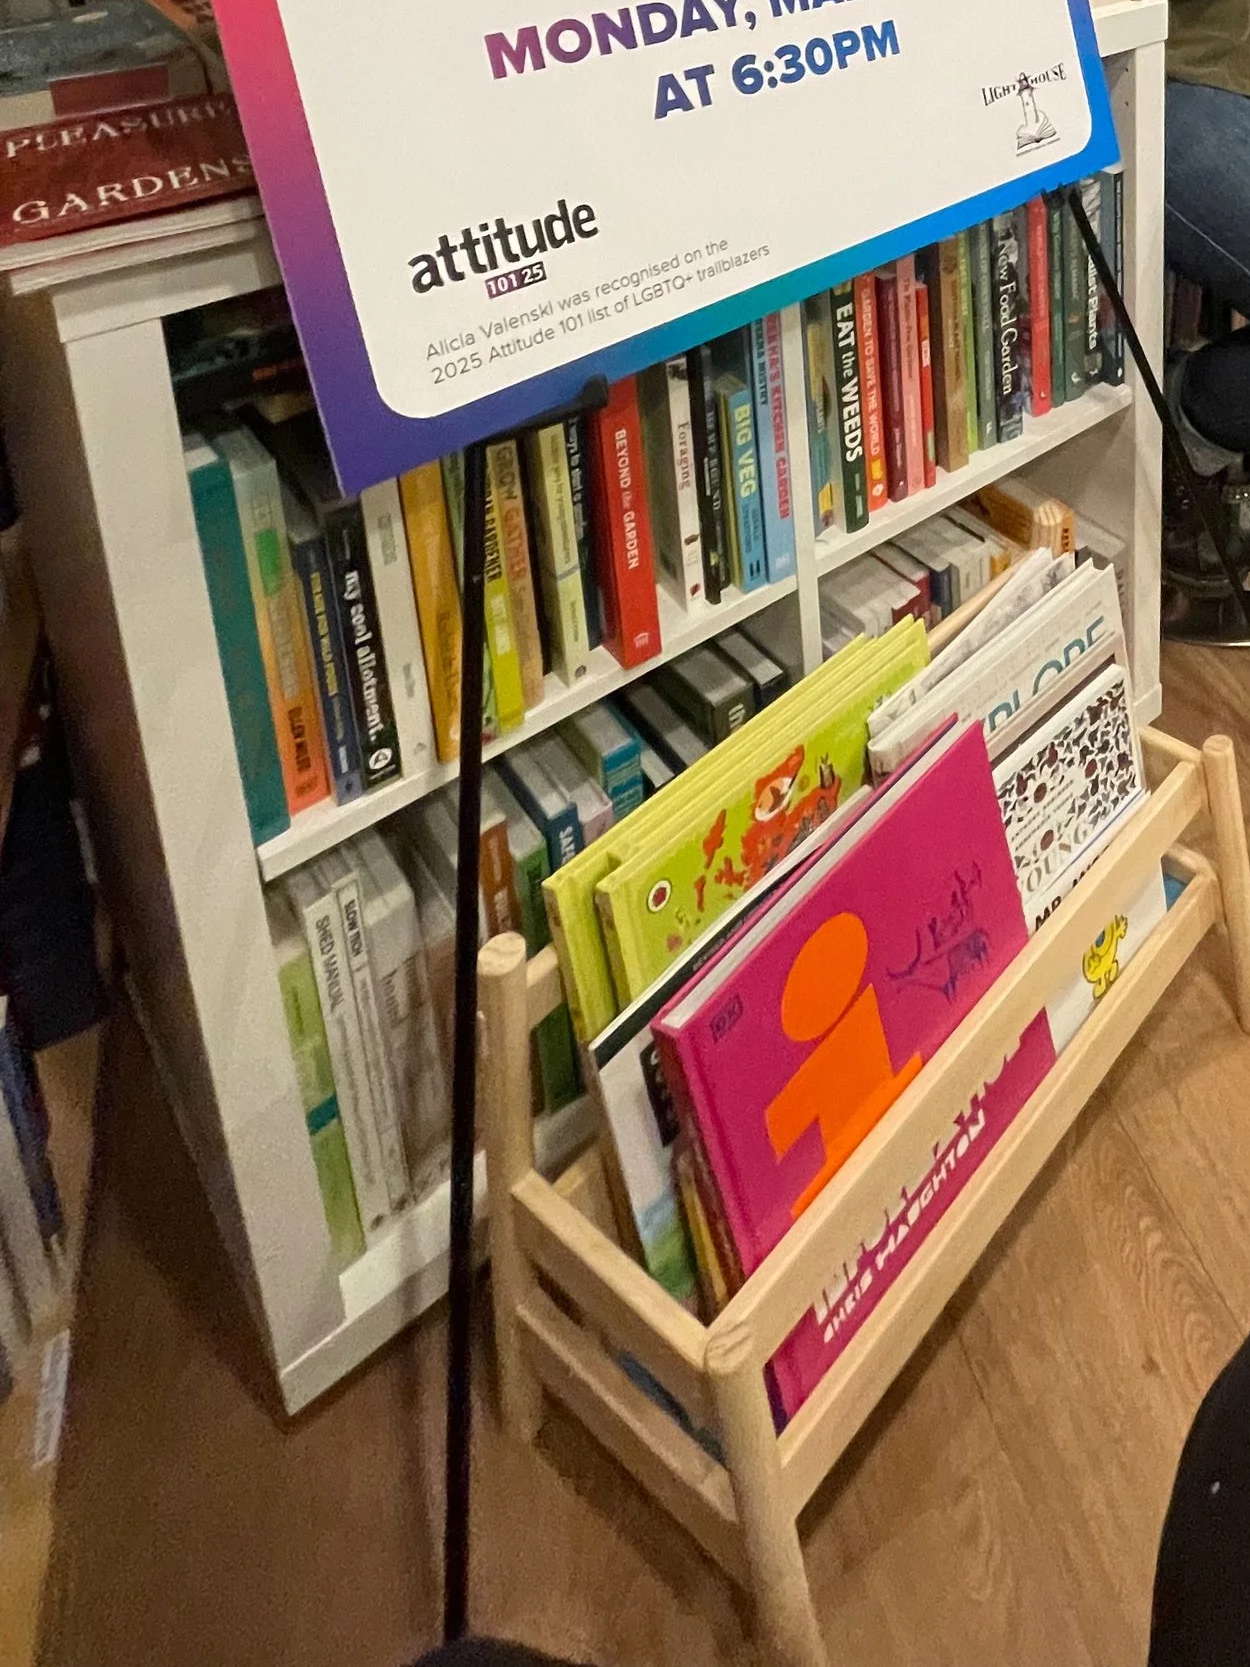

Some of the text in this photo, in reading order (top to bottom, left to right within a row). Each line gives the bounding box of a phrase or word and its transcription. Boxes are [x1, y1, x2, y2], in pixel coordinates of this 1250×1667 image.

[653, 20, 901, 120] AT 6:30PM
[6, 99, 236, 159] PLEASURE
[12, 154, 255, 226] GARDENS
[408, 199, 599, 294] attitude
[426, 237, 728, 361] Alicia Valenski was recognised on the
[432, 241, 771, 385] 2025 Attitude 101 list of LGBTQ+ trailblazers
[487, 264, 545, 297] 101 25
[860, 287, 874, 337] GARDEN
[864, 339, 876, 355] TO
[998, 236, 1018, 396] New Food Garden
[1088, 300, 1099, 351] Plants
[758, 362, 768, 407] MISTRY
[836, 301, 863, 463] EAT the WEEDS
[867, 389, 880, 412] THE
[734, 402, 752, 447] BIG
[770, 383, 786, 454] KITCHEN
[869, 413, 882, 456] WORLD
[615, 429, 632, 488] BEYOND
[676, 421, 691, 490] Foraging
[737, 452, 758, 499] VEG
[775, 454, 791, 521] GARDEN
[623, 510, 640, 571] GARDEN
[344, 570, 385, 742] my cool allotment.
[315, 915, 345, 1015] SHED MANUAL
[823, 1108, 986, 1344] CHRIS HAUGHTON
